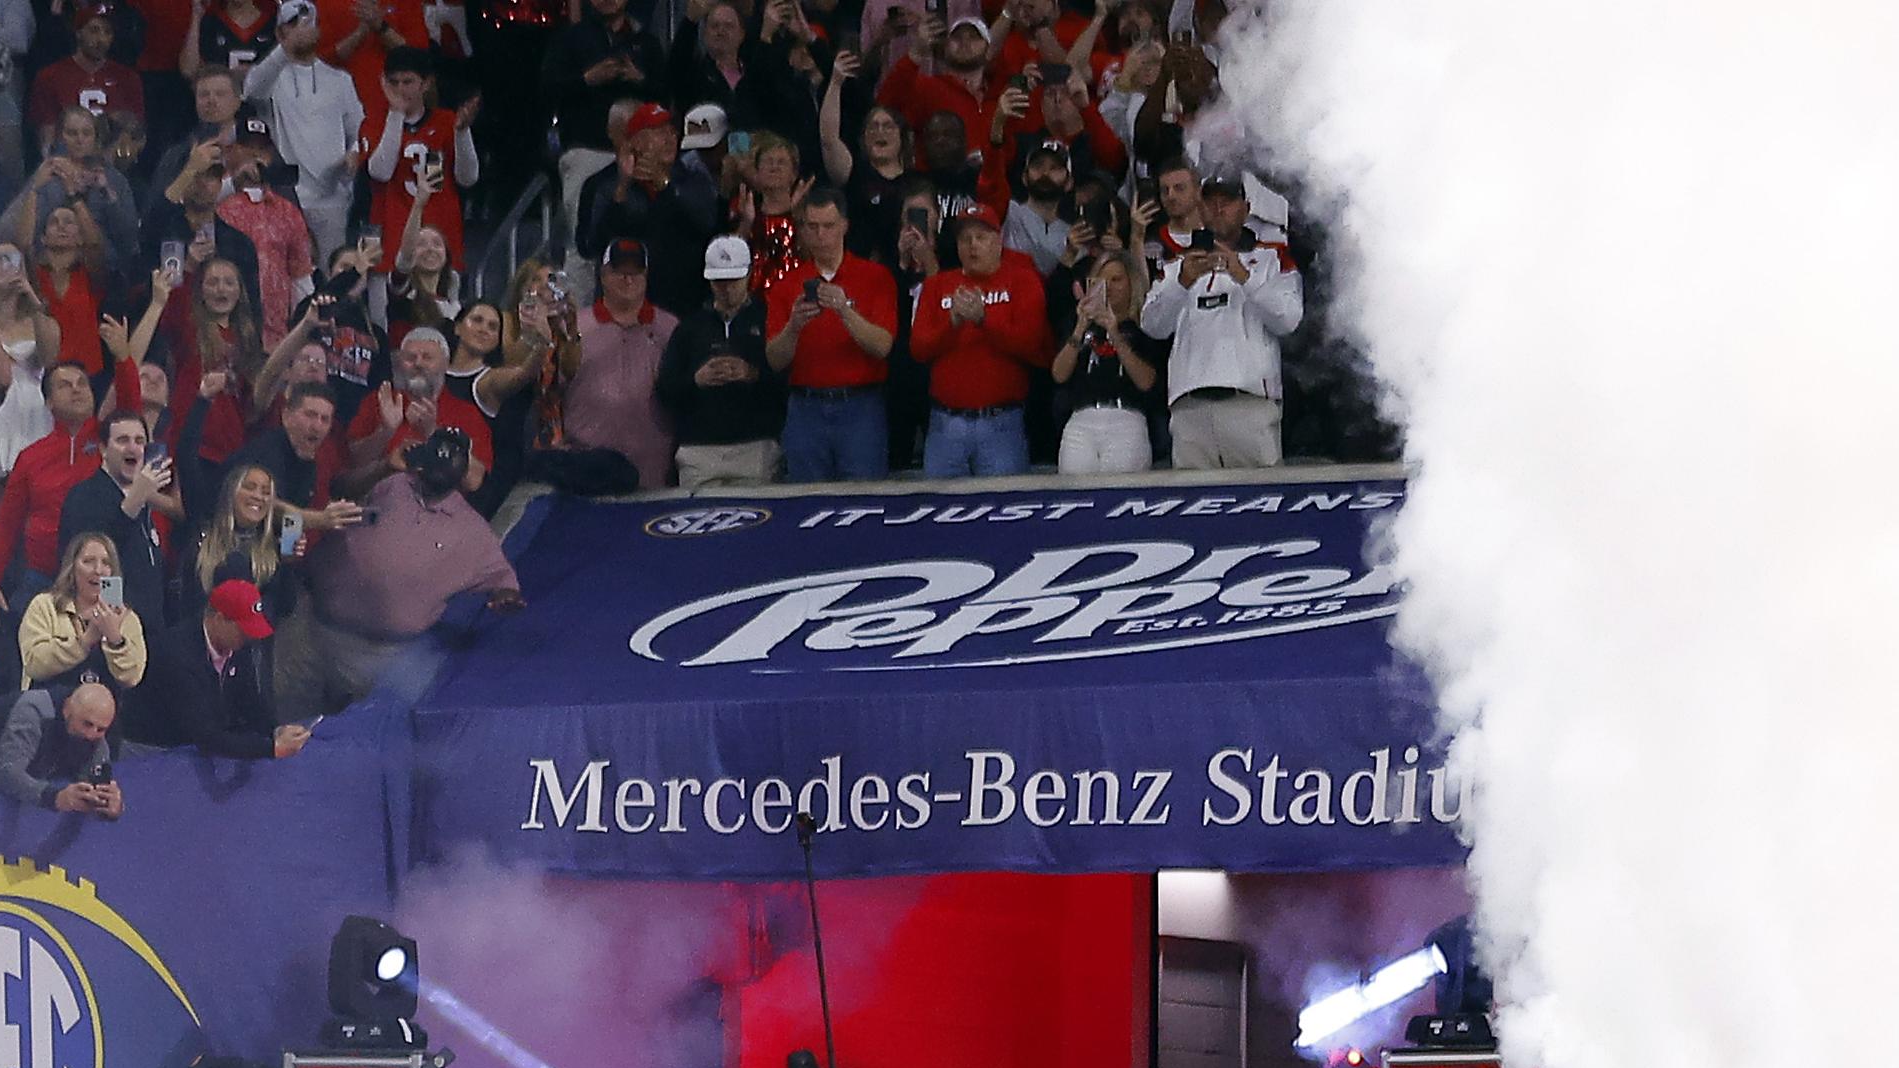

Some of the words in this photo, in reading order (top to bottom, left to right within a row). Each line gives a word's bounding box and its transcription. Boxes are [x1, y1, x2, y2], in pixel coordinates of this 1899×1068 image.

[655, 507, 760, 536] SEC
[800, 508, 885, 529] IT
[883, 501, 1095, 525] JUST
[1105, 492, 1404, 518] MEANS
[965, 538, 1322, 607] Dr
[629, 561, 1404, 667] Pepper
[1215, 599, 1348, 626] 1885
[521, 749, 1173, 835] Mercedes-Benz
[1203, 745, 1474, 826] Stadiu
